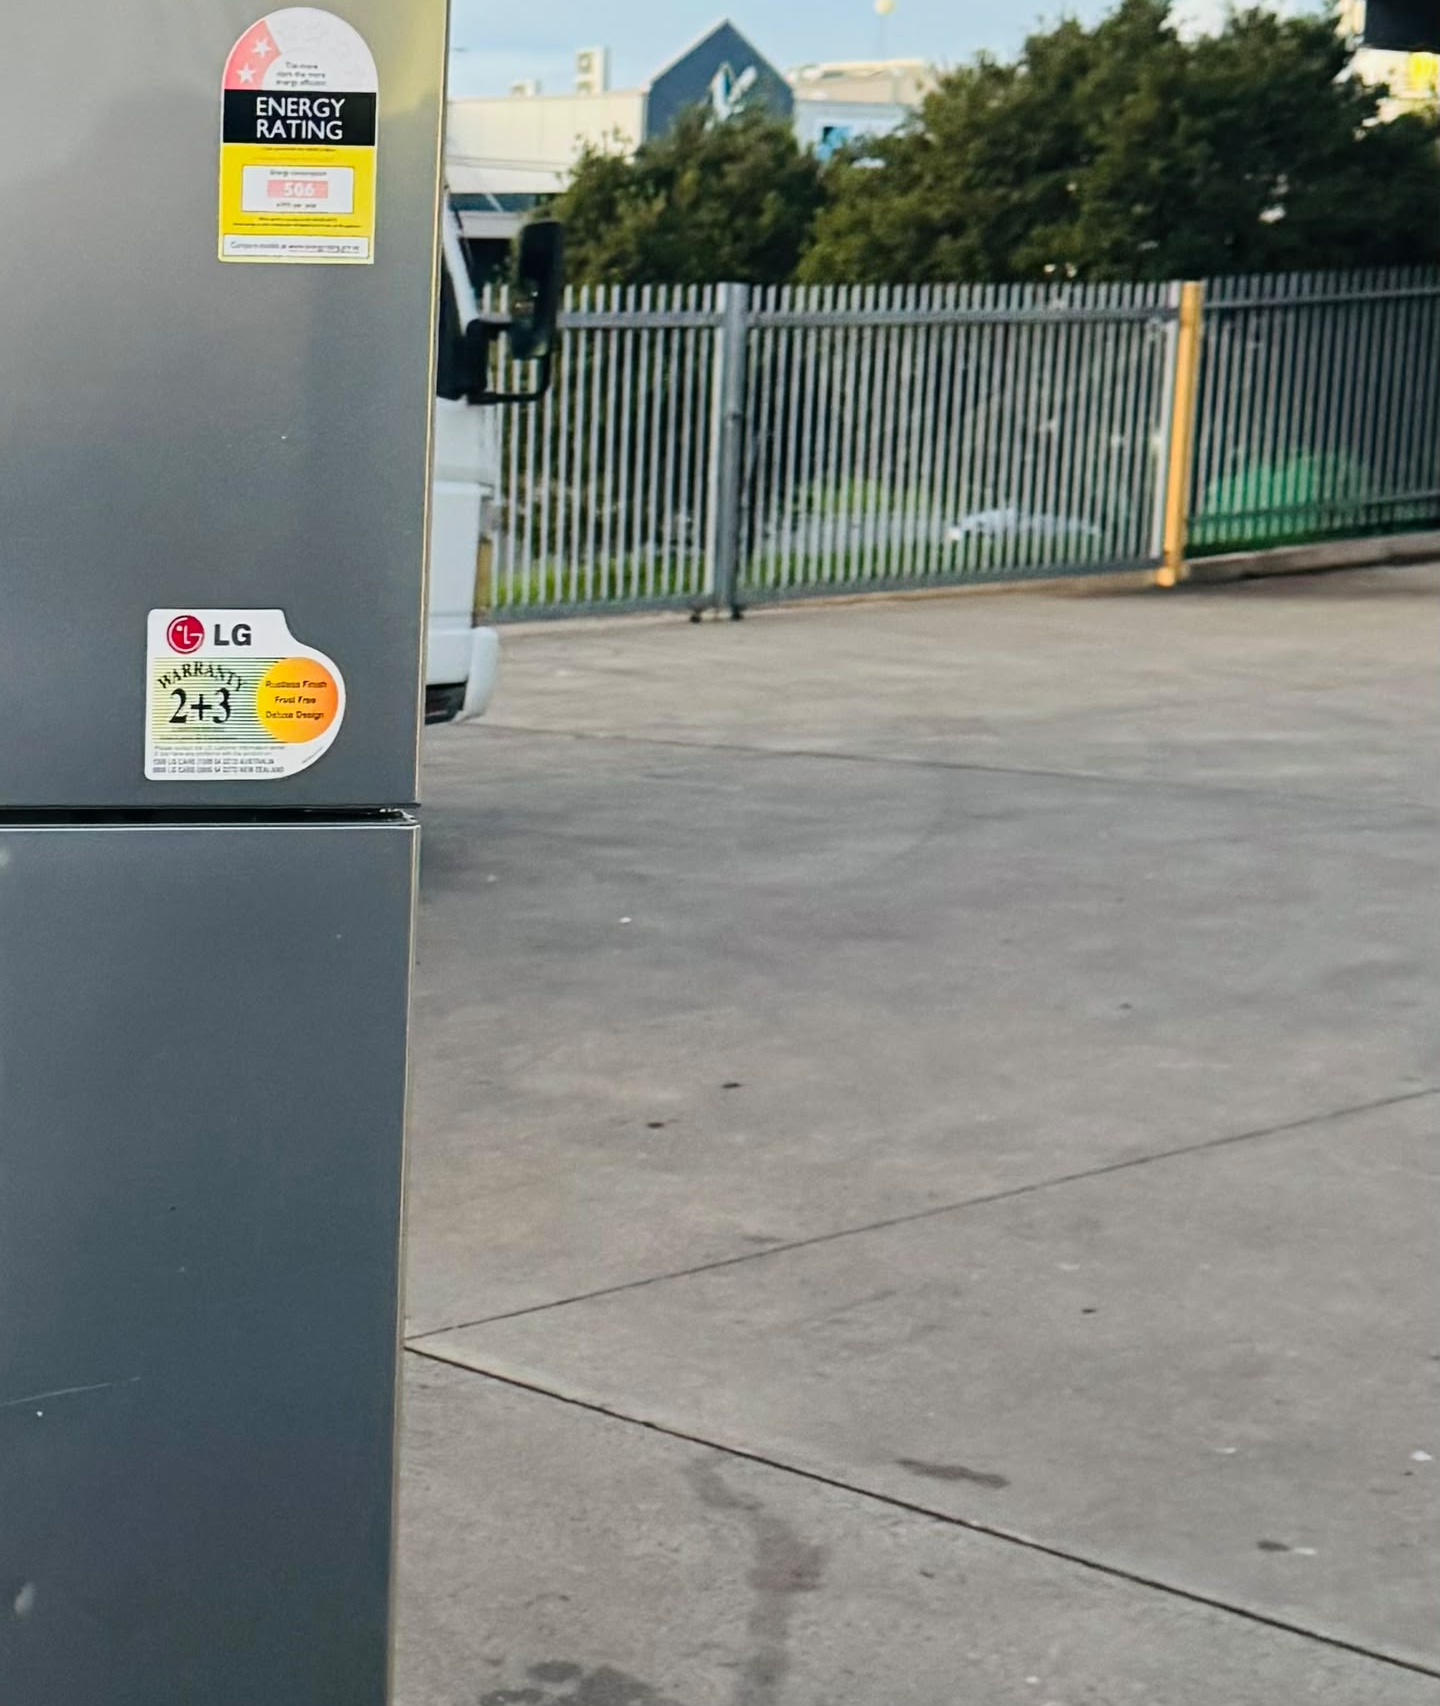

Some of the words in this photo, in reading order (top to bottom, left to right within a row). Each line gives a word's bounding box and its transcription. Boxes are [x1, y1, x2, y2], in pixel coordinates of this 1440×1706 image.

[256, 96, 346, 118] ENERGY
[256, 119, 343, 140] RATING
[283, 181, 316, 198] 506
[214, 623, 252, 646] LG
[157, 660, 246, 692] WARRANTY
[168, 688, 231, 723] 2+3
